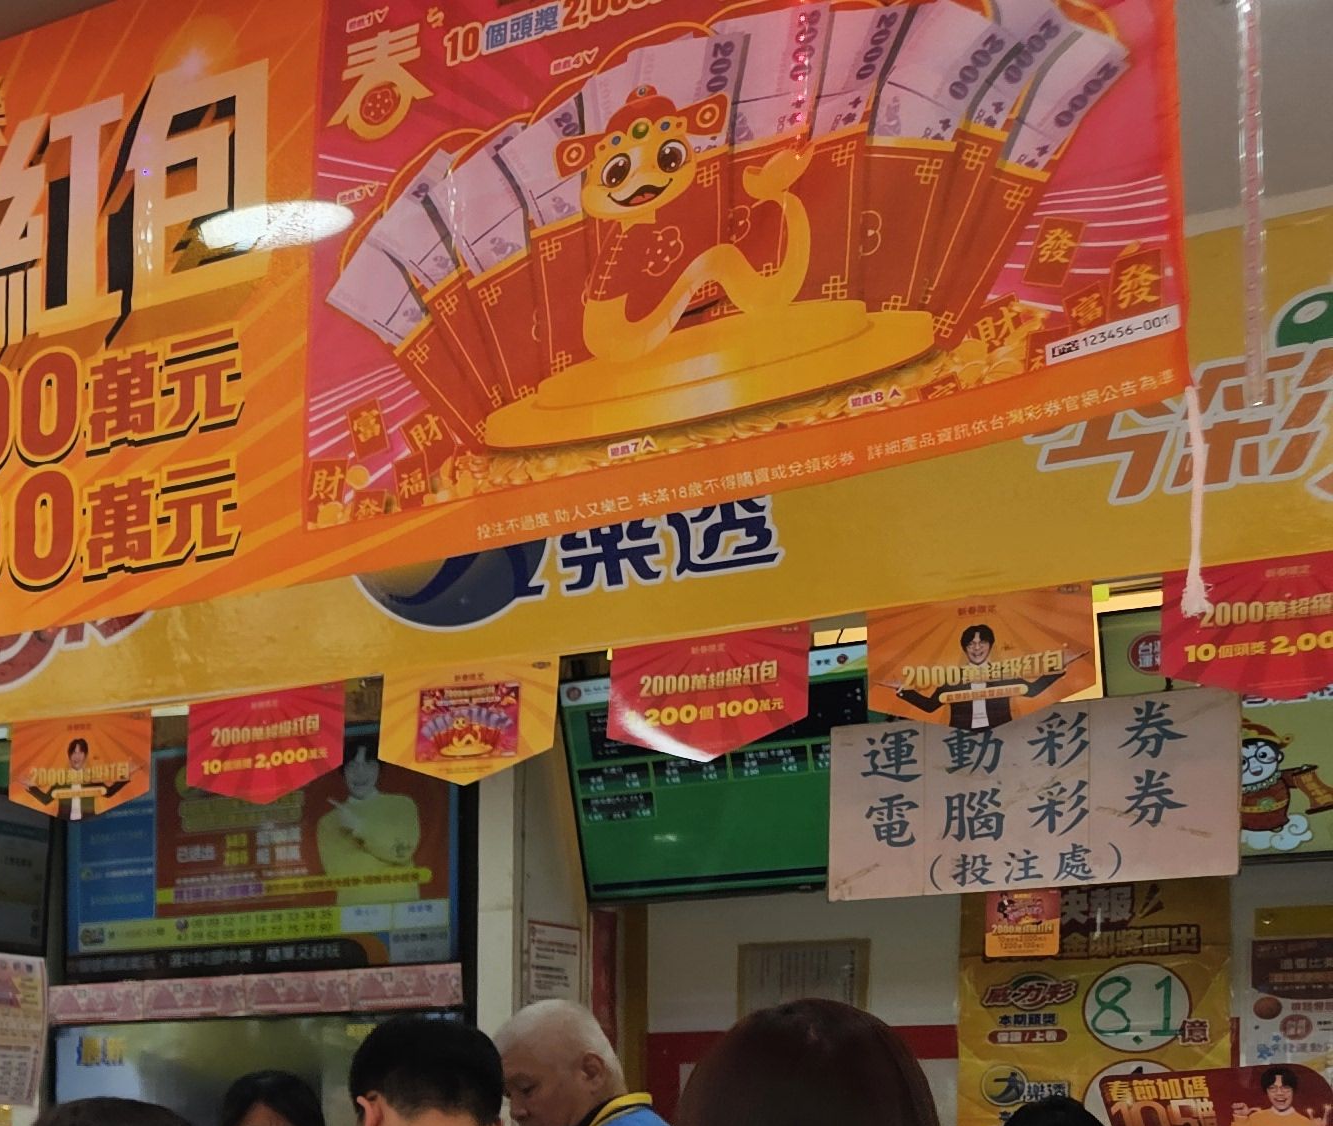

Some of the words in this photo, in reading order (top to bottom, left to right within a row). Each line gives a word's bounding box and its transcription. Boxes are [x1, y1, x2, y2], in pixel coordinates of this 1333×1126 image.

[326, 24, 434, 141] 春
[1082, 313, 1171, 348] 123456-001
[862, 700, 1187, 783] 運動彩券
[864, 769, 1187, 849] 電腦彩券
[930, 842, 1124, 891] (投注處)
[983, 976, 1079, 1008] 威力彩
[1108, 1075, 1210, 1102] 春節加碼
